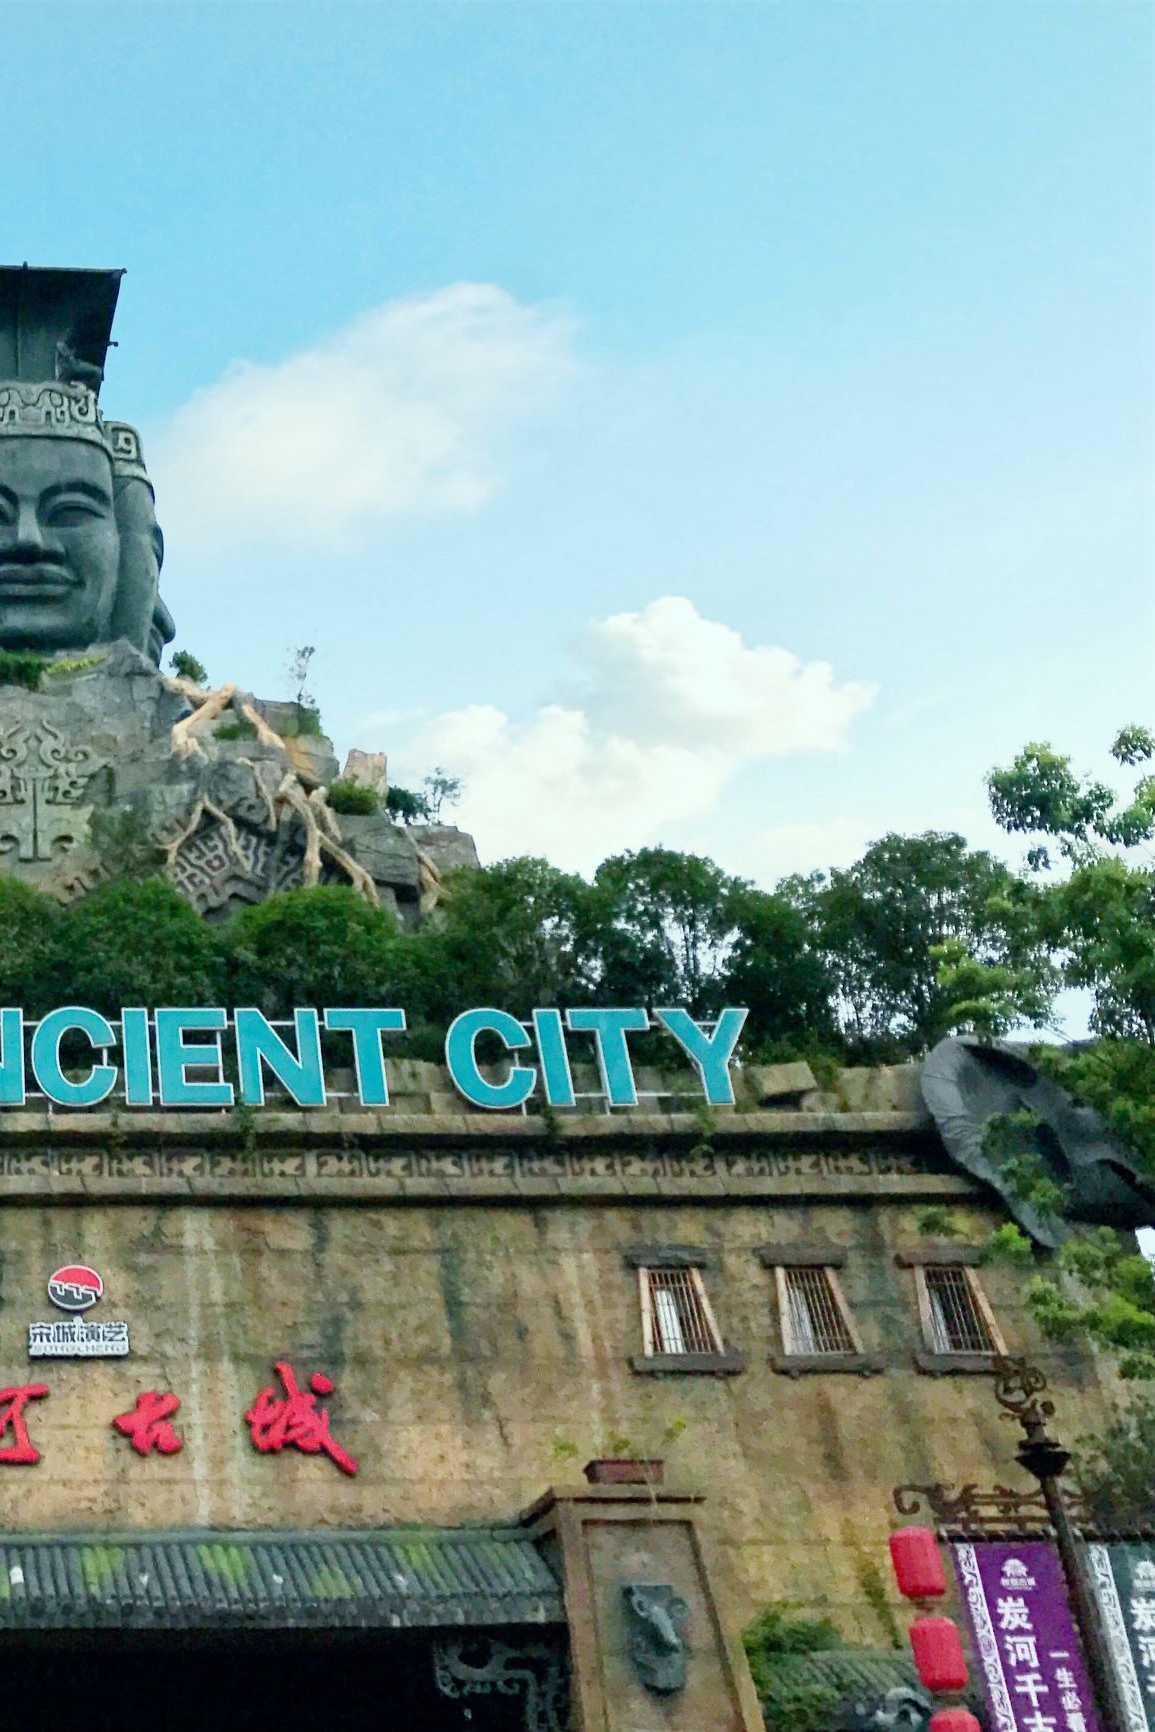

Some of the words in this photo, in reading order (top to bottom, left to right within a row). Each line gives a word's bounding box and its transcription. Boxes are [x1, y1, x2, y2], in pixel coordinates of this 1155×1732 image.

[445, 1007, 749, 1109] CITY
[31, 1324, 126, 1343] 宋城演艺
